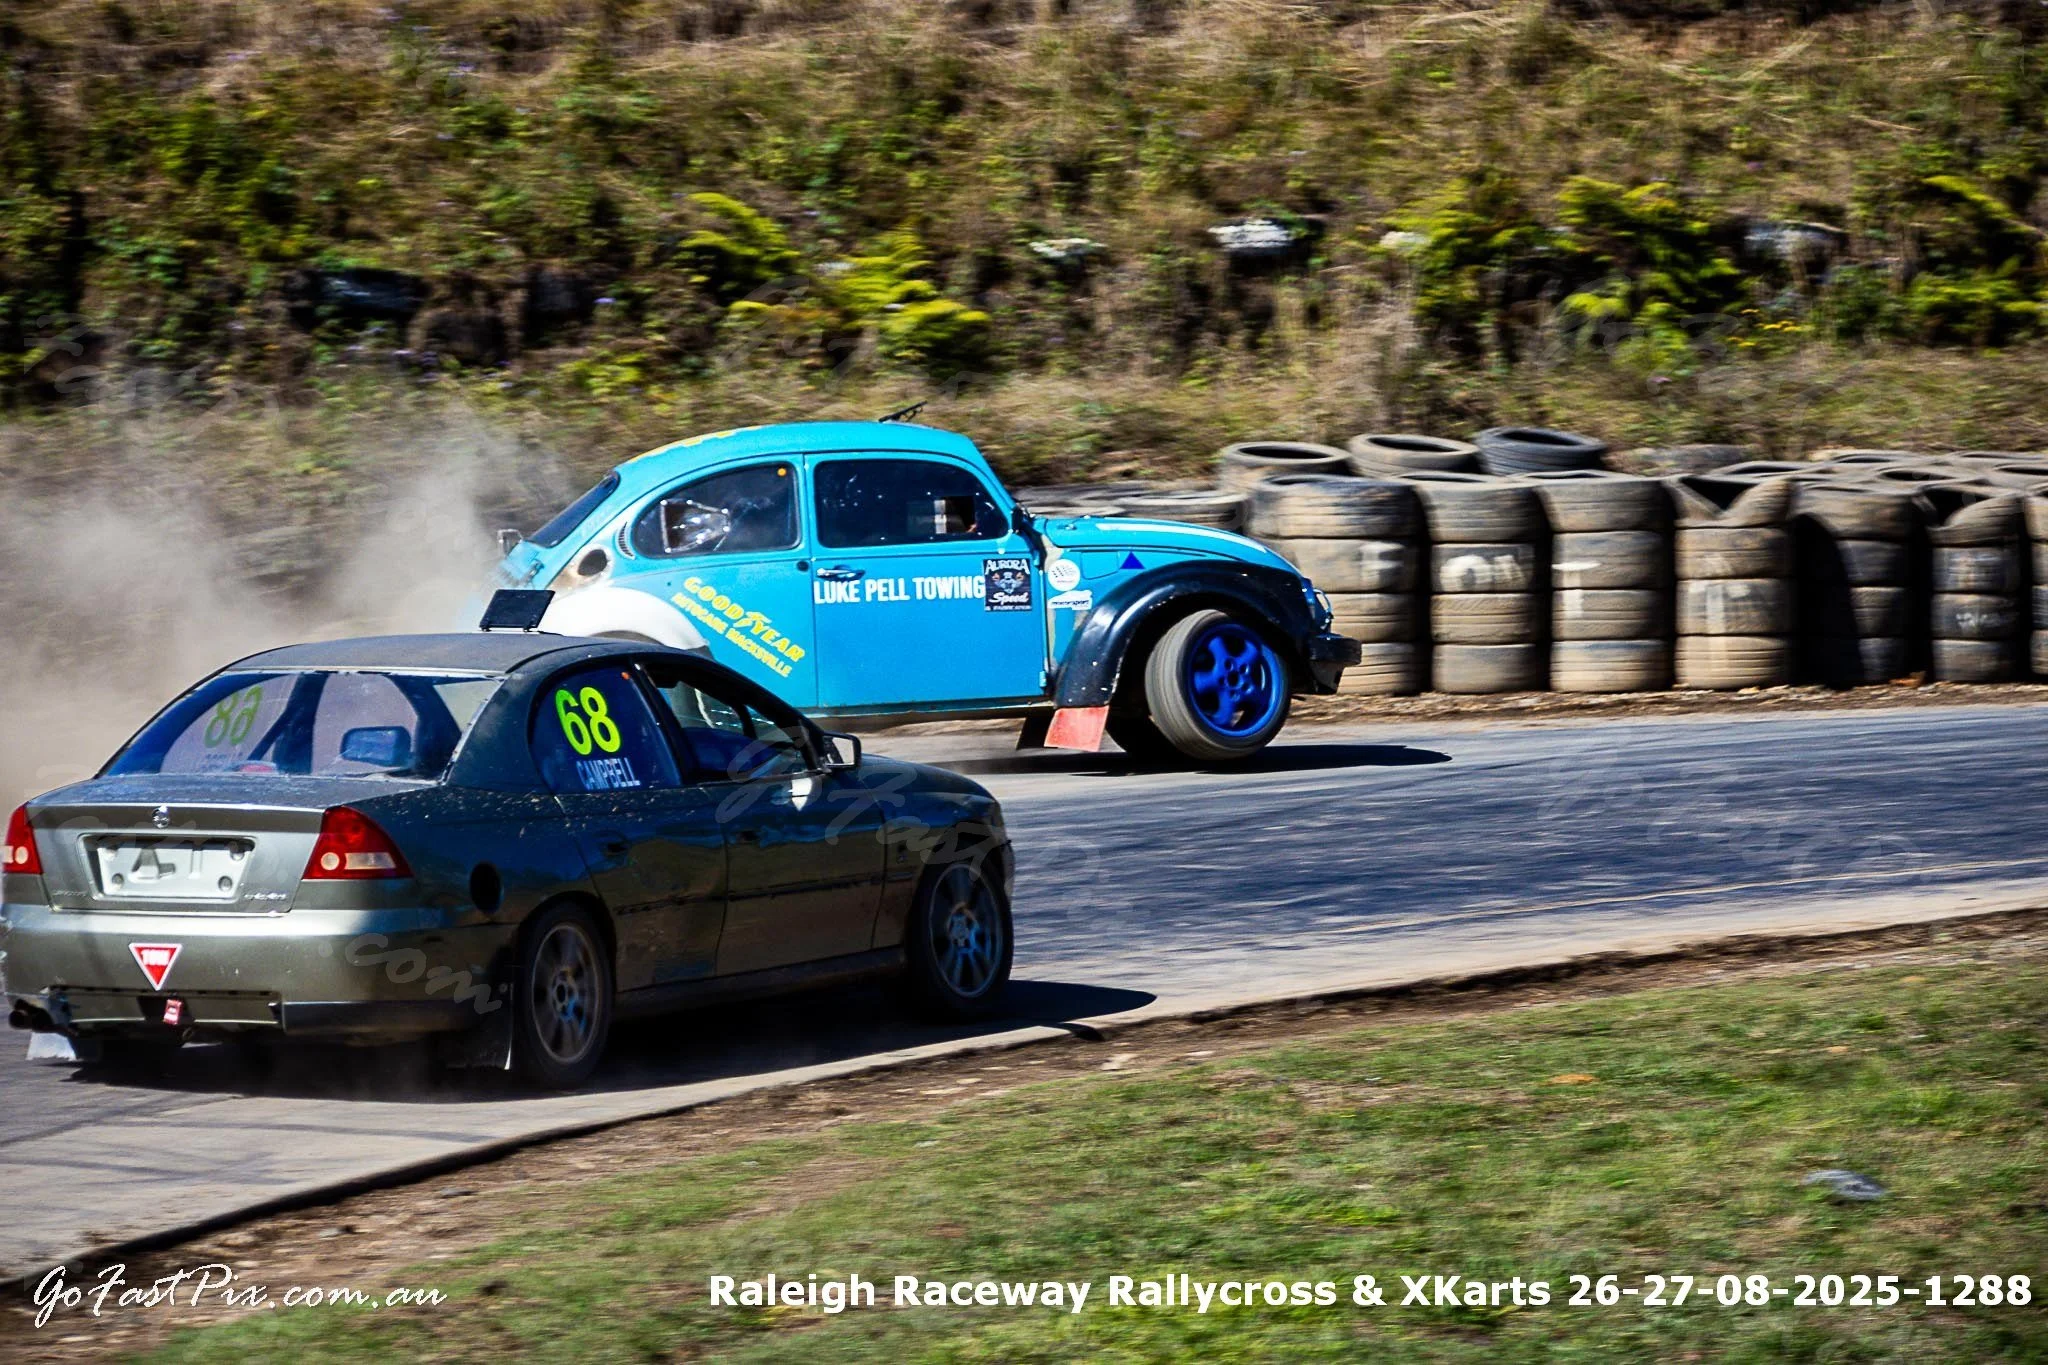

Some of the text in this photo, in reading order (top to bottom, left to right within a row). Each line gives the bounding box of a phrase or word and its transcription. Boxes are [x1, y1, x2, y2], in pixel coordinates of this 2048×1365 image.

[984, 559, 1031, 575] AURORA
[814, 575, 986, 604] LUKE PELL TOWING
[683, 576, 806, 662] GOODYEAR
[555, 686, 621, 756] 68
[576, 757, 641, 791] CAMPBELL
